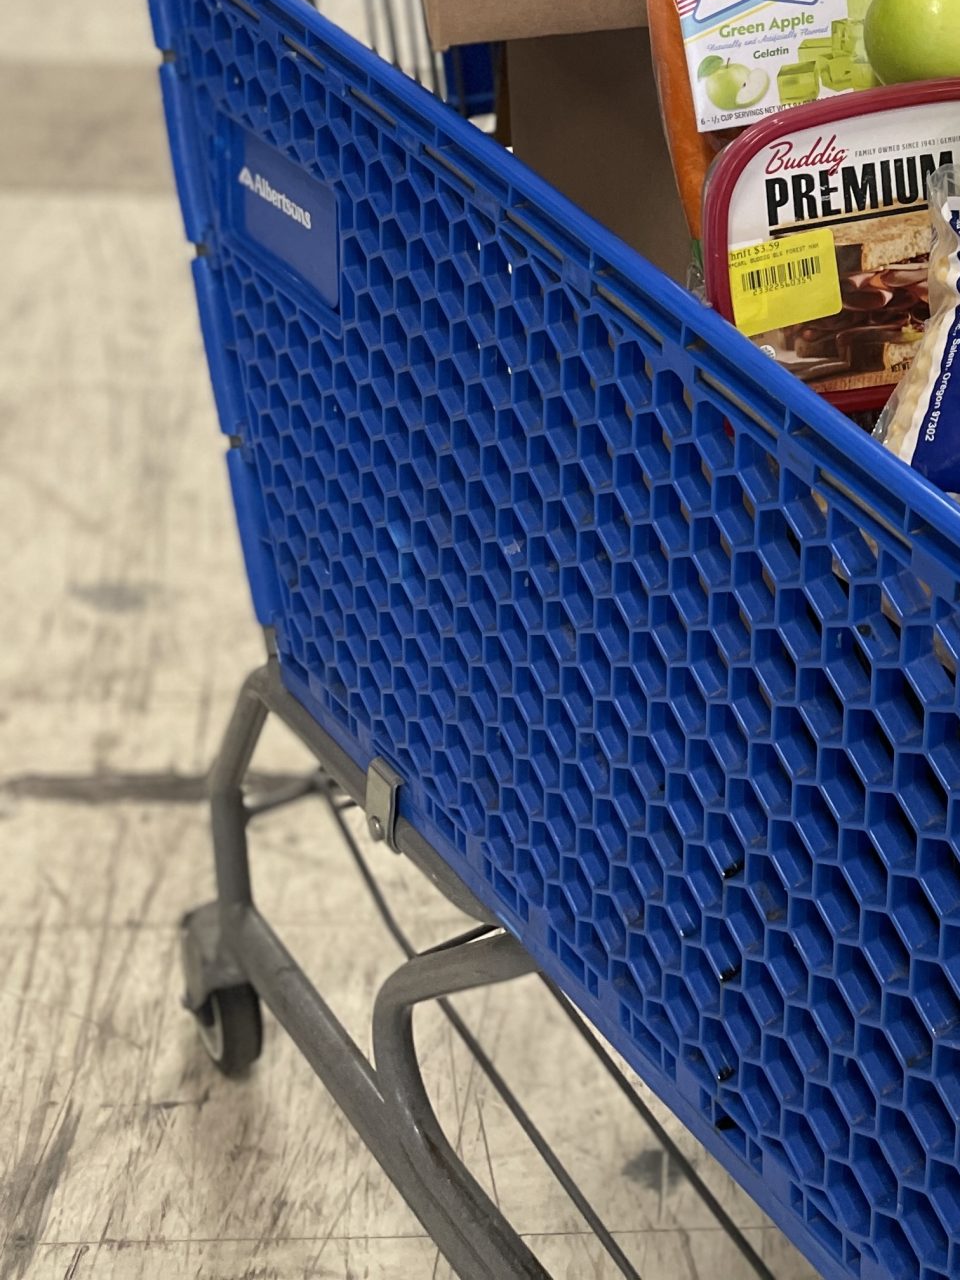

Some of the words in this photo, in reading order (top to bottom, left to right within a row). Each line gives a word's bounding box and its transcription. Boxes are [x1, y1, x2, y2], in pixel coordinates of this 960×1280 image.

[719, 22, 765, 39] Green
[769, 12, 815, 32] Apple
[753, 46, 789, 60] Gelatin
[720, 113, 734, 123] CUP
[734, 108, 764, 120] SERVINGS
[764, 106, 777, 115] NET
[765, 134, 848, 177] Buddig
[855, 148, 877, 158] FAMILY
[878, 144, 901, 155] OWNED
[902, 141, 920, 151] SINCE
[921, 138, 937, 147] 1943
[254, 173, 312, 230] Albertsons
[765, 151, 953, 227] PREMIUM
[730, 248, 752, 261] hrift
[754, 241, 780, 255] $3.59
[934, 372, 951, 409] Oregon
[925, 410, 941, 442] 97302
